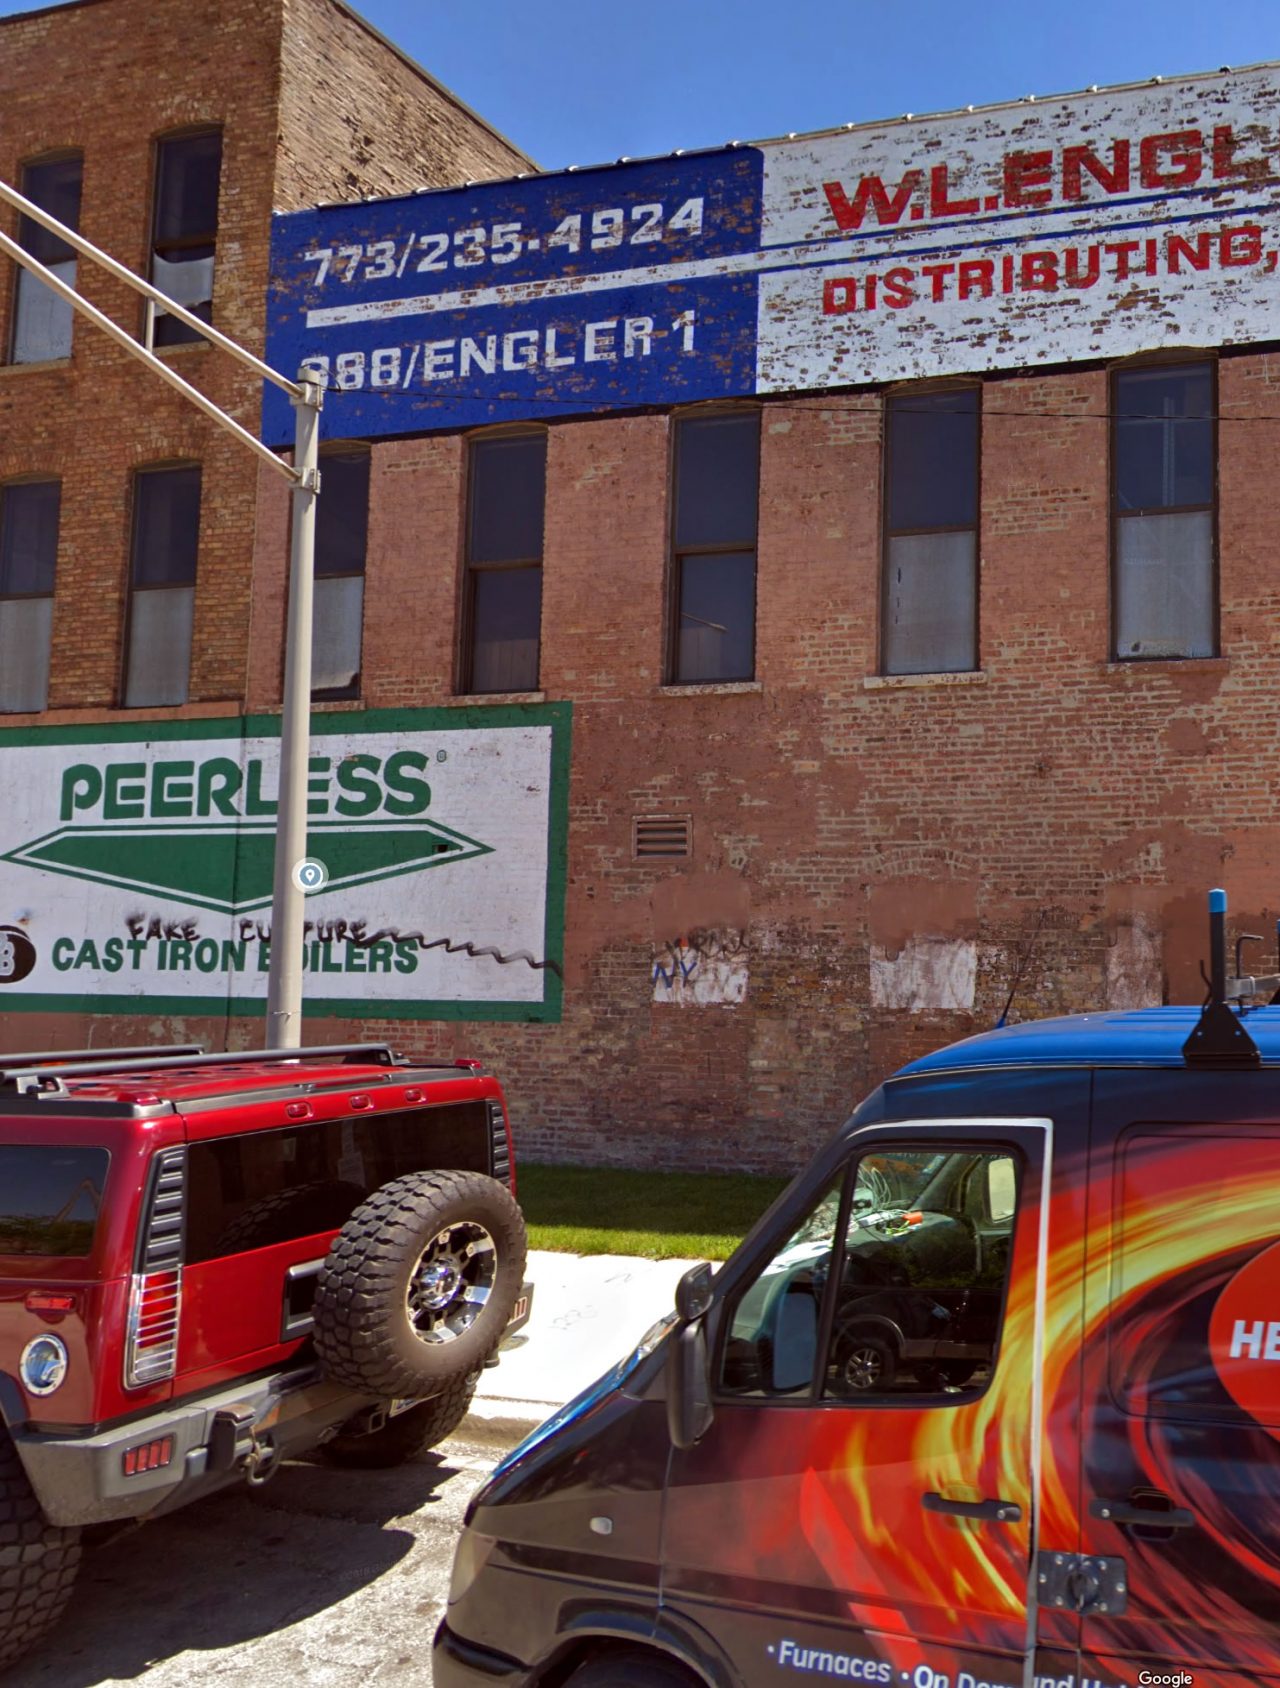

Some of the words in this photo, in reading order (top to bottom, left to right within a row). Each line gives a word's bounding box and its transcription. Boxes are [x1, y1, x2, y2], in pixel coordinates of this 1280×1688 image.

[672, 310, 696, 352] 1
[60, 750, 432, 822] PEERLESS
[125, 912, 201, 942] FAKE
[240, 918, 369, 944] CUTURE
[52, 937, 147, 973] CAST
[157, 938, 247, 973] IRON
[258, 938, 418, 974] BILERS
[778, 1640, 892, 1683] Furnaces
